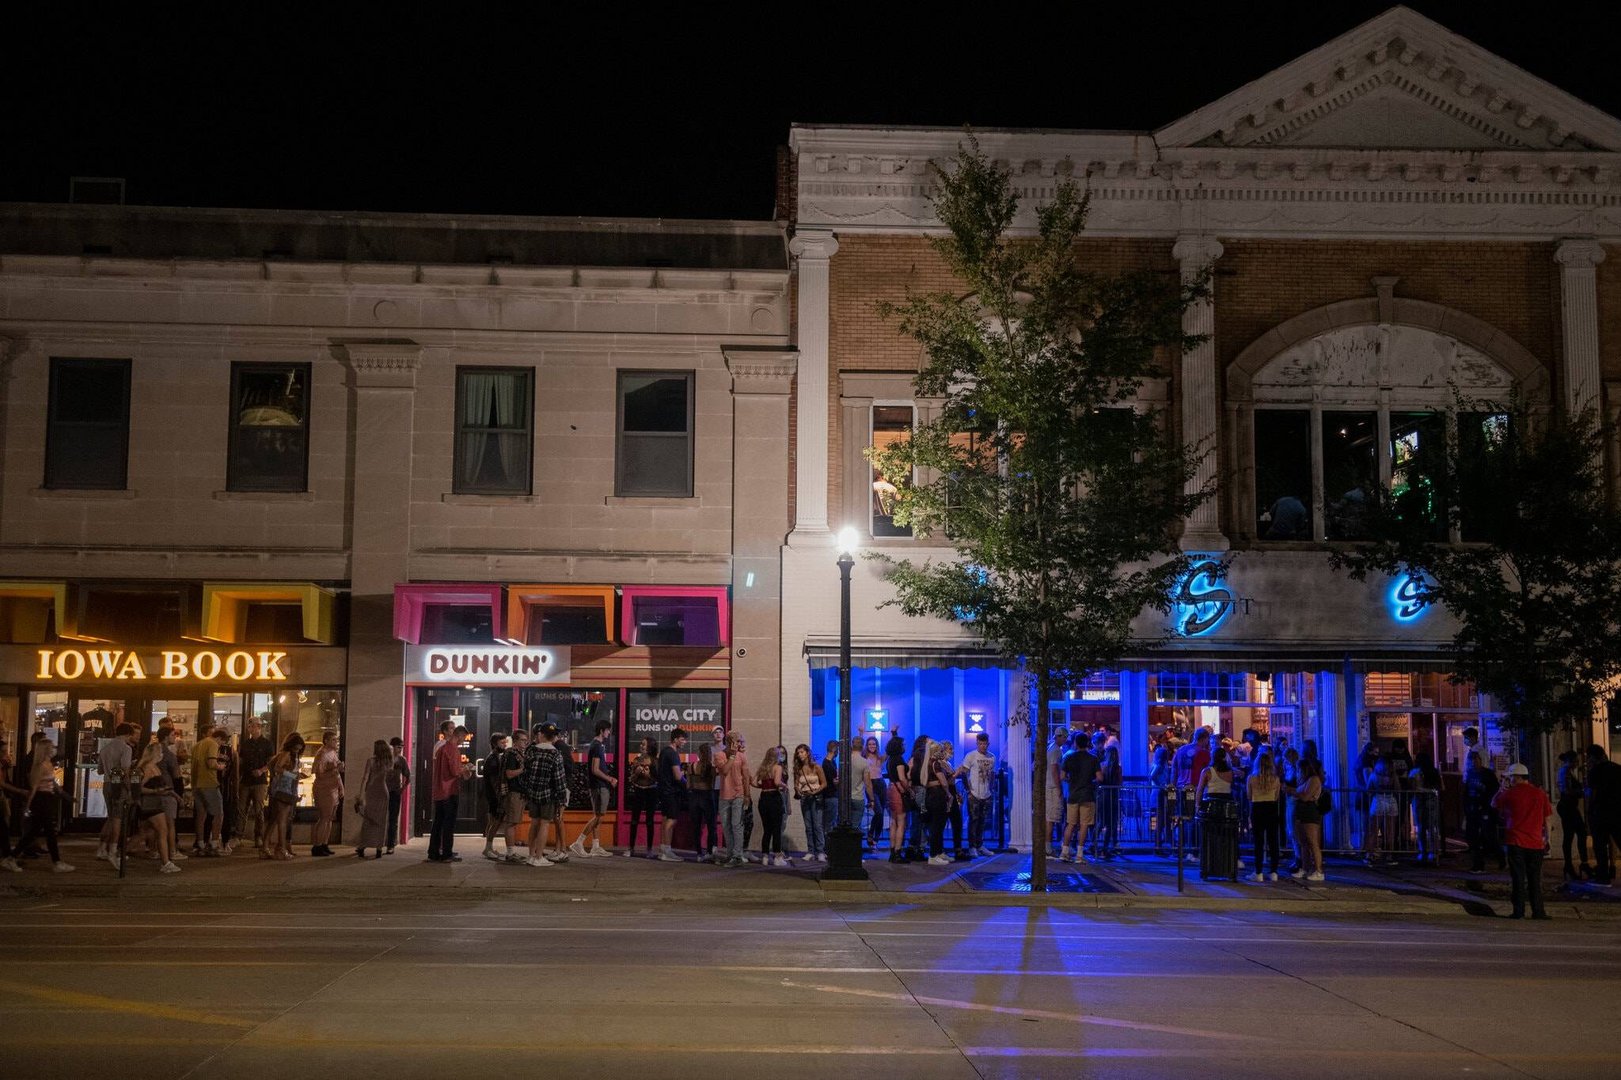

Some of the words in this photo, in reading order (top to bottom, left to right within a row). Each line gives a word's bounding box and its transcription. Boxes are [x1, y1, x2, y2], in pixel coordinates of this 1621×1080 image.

[36, 649, 147, 680] IOWA
[160, 650, 287, 681] BOOK
[430, 654, 547, 675] DUNKIN'
[635, 708, 679, 721] IOWA
[682, 708, 716, 721] CITY
[635, 724, 661, 732] RUNS
[663, 724, 677, 732] ON
